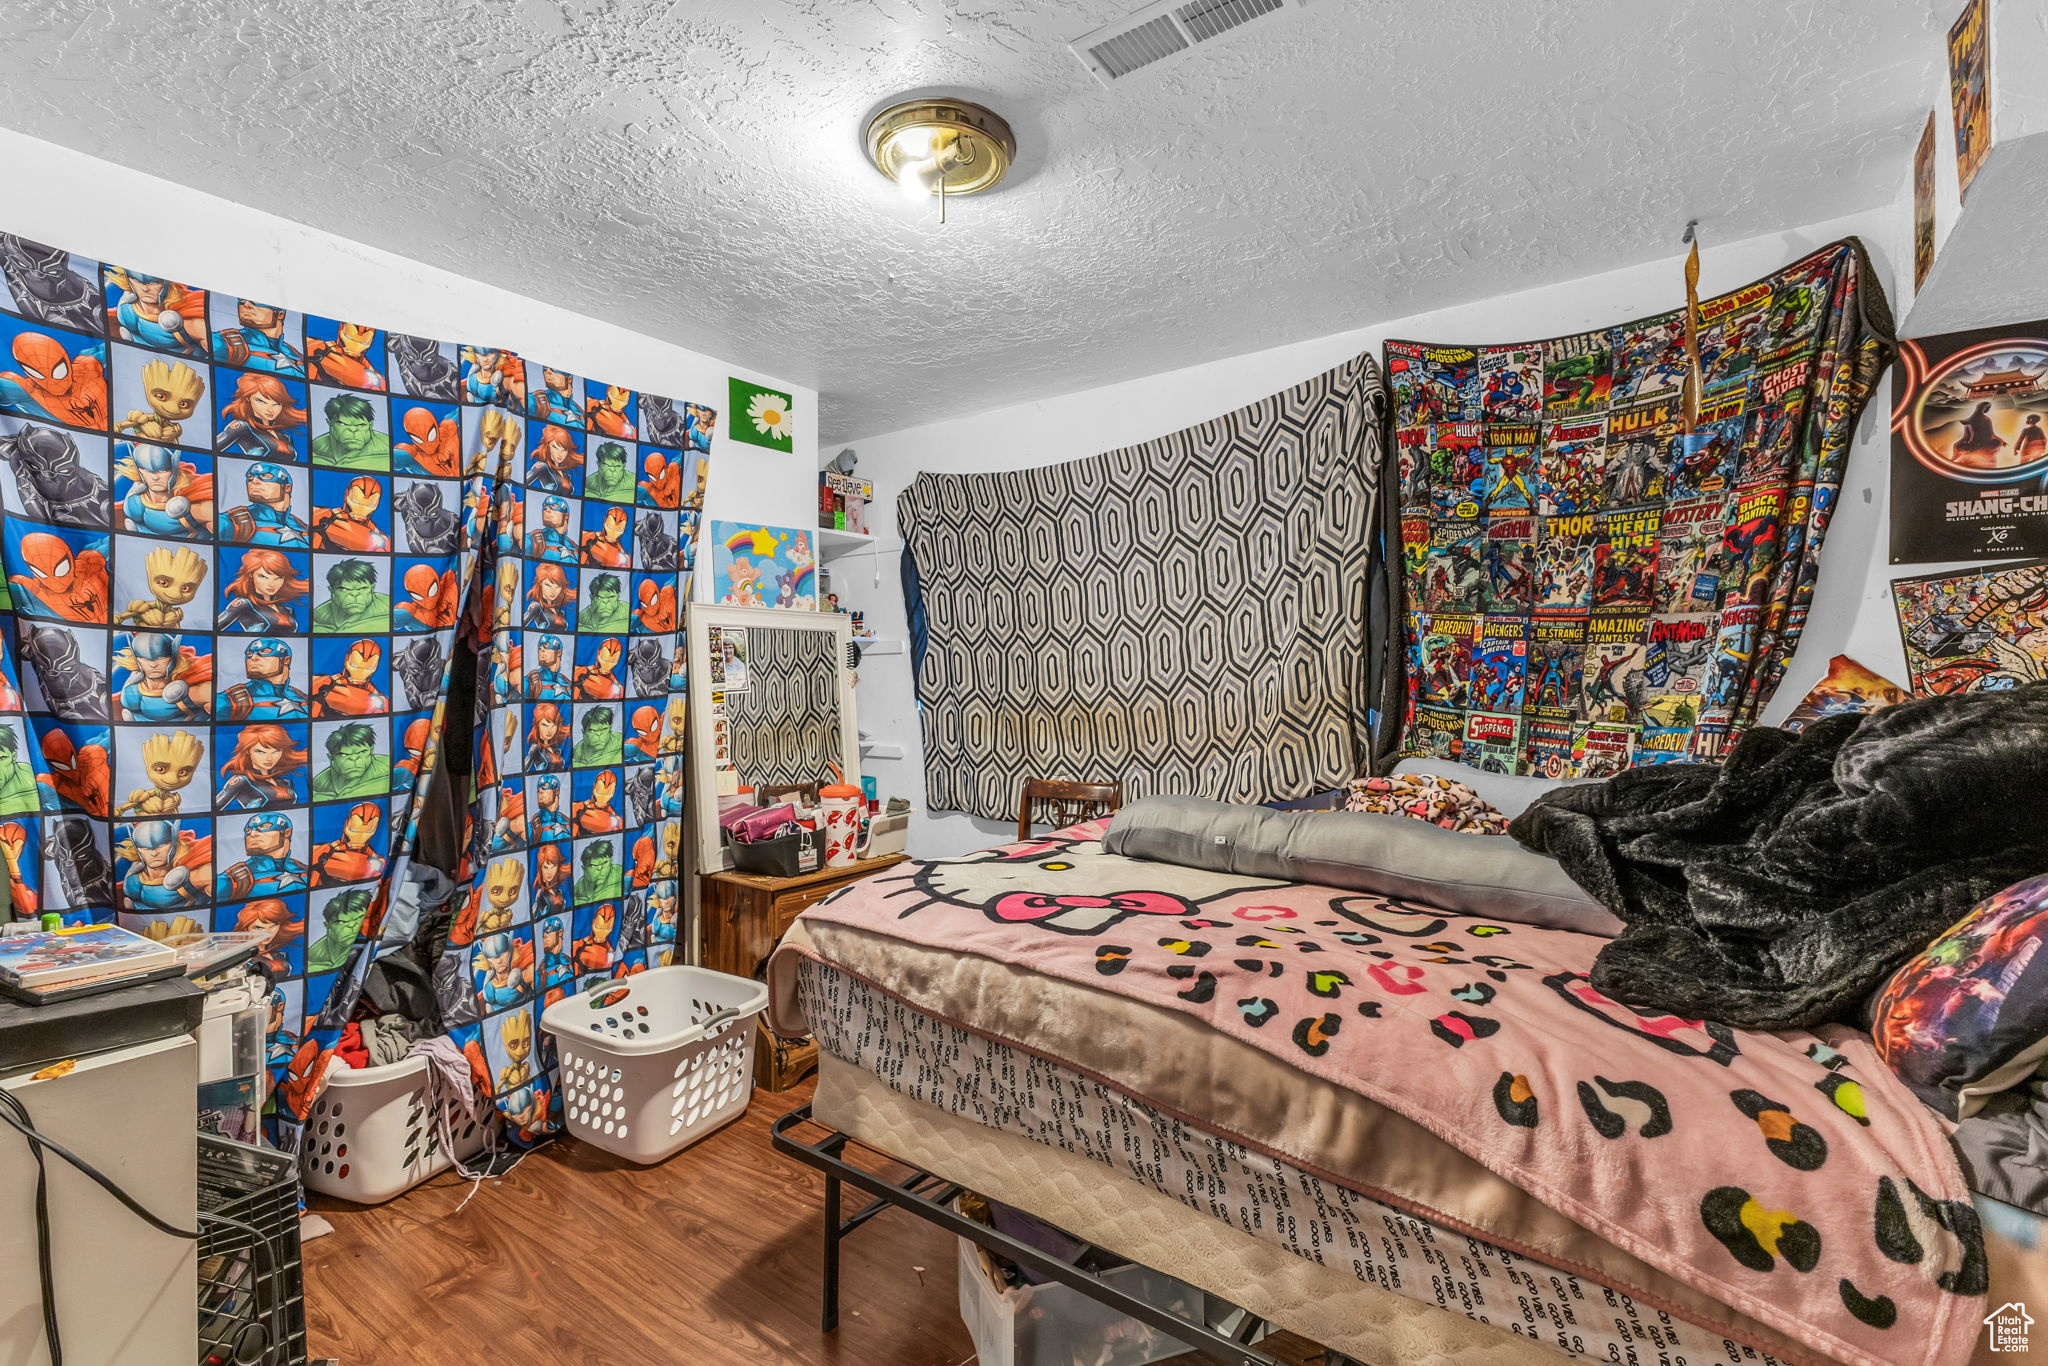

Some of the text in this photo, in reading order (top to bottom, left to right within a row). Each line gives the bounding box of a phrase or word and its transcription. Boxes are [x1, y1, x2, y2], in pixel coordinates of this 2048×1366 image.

[1703, 284, 1771, 319] IRON MAN
[1762, 361, 1808, 390] GHOST
[1764, 374, 1806, 404] RIDER
[1609, 406, 1670, 432] HULK
[1455, 425, 1477, 437] HULK
[1490, 431, 1537, 445] IRON MAN
[1548, 424, 1602, 446] AVENGERS
[1663, 502, 1724, 524] MYSTERY
[1740, 495, 1777, 514] BLACK
[1946, 495, 2048, 518] SHANG-CH
[1546, 515, 1594, 537] THOR
[1608, 509, 1662, 523] LUKE CAGE
[1608, 517, 1660, 535] HERO
[1610, 533, 1655, 549] HIRE
[1432, 620, 1473, 635] DAREDEVIL
[1484, 622, 1524, 638] AVENGERS
[1549, 628, 1584, 638] STRANGE
[1589, 618, 1644, 633] AMAZING
[1482, 640, 1509, 648] CAPTAIN
[1595, 634, 1635, 643] FANTASY
[1417, 712, 1465, 731] SPIDER-MAN
[1429, 710, 1457, 720] AMAZING
[1470, 716, 1511, 737] SUSPENSE
[1585, 742, 1627, 751] AVENGERS
[1152, 1139, 1163, 1183] GOOD VIBES
[1207, 1154, 1219, 1175] GOOD
[1258, 1183, 1269, 1204] VIBES
[1299, 1174, 1312, 1196] VIBES
[1312, 1178, 1325, 1203] GOOD
[1247, 1183, 1262, 1229] GOOD VIBES
[1279, 1187, 1291, 1208] VIBES
[1240, 1207, 1251, 1230] GOOD
[1270, 1186, 1285, 1234] GOOD VIBES
[1288, 1216, 1297, 1242] GOOD
[1310, 1220, 1320, 1247] GOOD
[1323, 1221, 1333, 1243] VIBES
[1383, 1215, 1408, 1259] GOOD VIBES
[1395, 1216, 1410, 1237] VIBES
[1346, 1227, 1359, 1249] VIBES
[1409, 1220, 1435, 1265] GOOD VIBES
[1359, 1231, 1376, 1283] GOOD VIBES
[1381, 1237, 1401, 1289] GOOD VIBES
[1353, 1260, 1365, 1281] GOOD
[1377, 1265, 1391, 1291] GOOD
[1434, 1249, 1457, 1300] GOOD VIBES
[1461, 1256, 1485, 1306] GOOD VIBES
[1432, 1275, 1446, 1305] GOOD
[1458, 1282, 1473, 1310] GOOD
[1521, 1272, 1547, 1319] GOOD VIBES
[1567, 1277, 1584, 1300] VIBES
[1518, 1296, 1534, 1323] GOOD
[1550, 1276, 1578, 1325] GOOD VIBES
[1547, 1302, 1564, 1329] GOOD
[1615, 1318, 1632, 1343] GOOD
[1630, 1320, 1647, 1339] VIBES
[1648, 1325, 1666, 1350] GOOD
[1663, 1326, 1680, 1345] VIBES
[1723, 1339, 1742, 1363] GOOD
